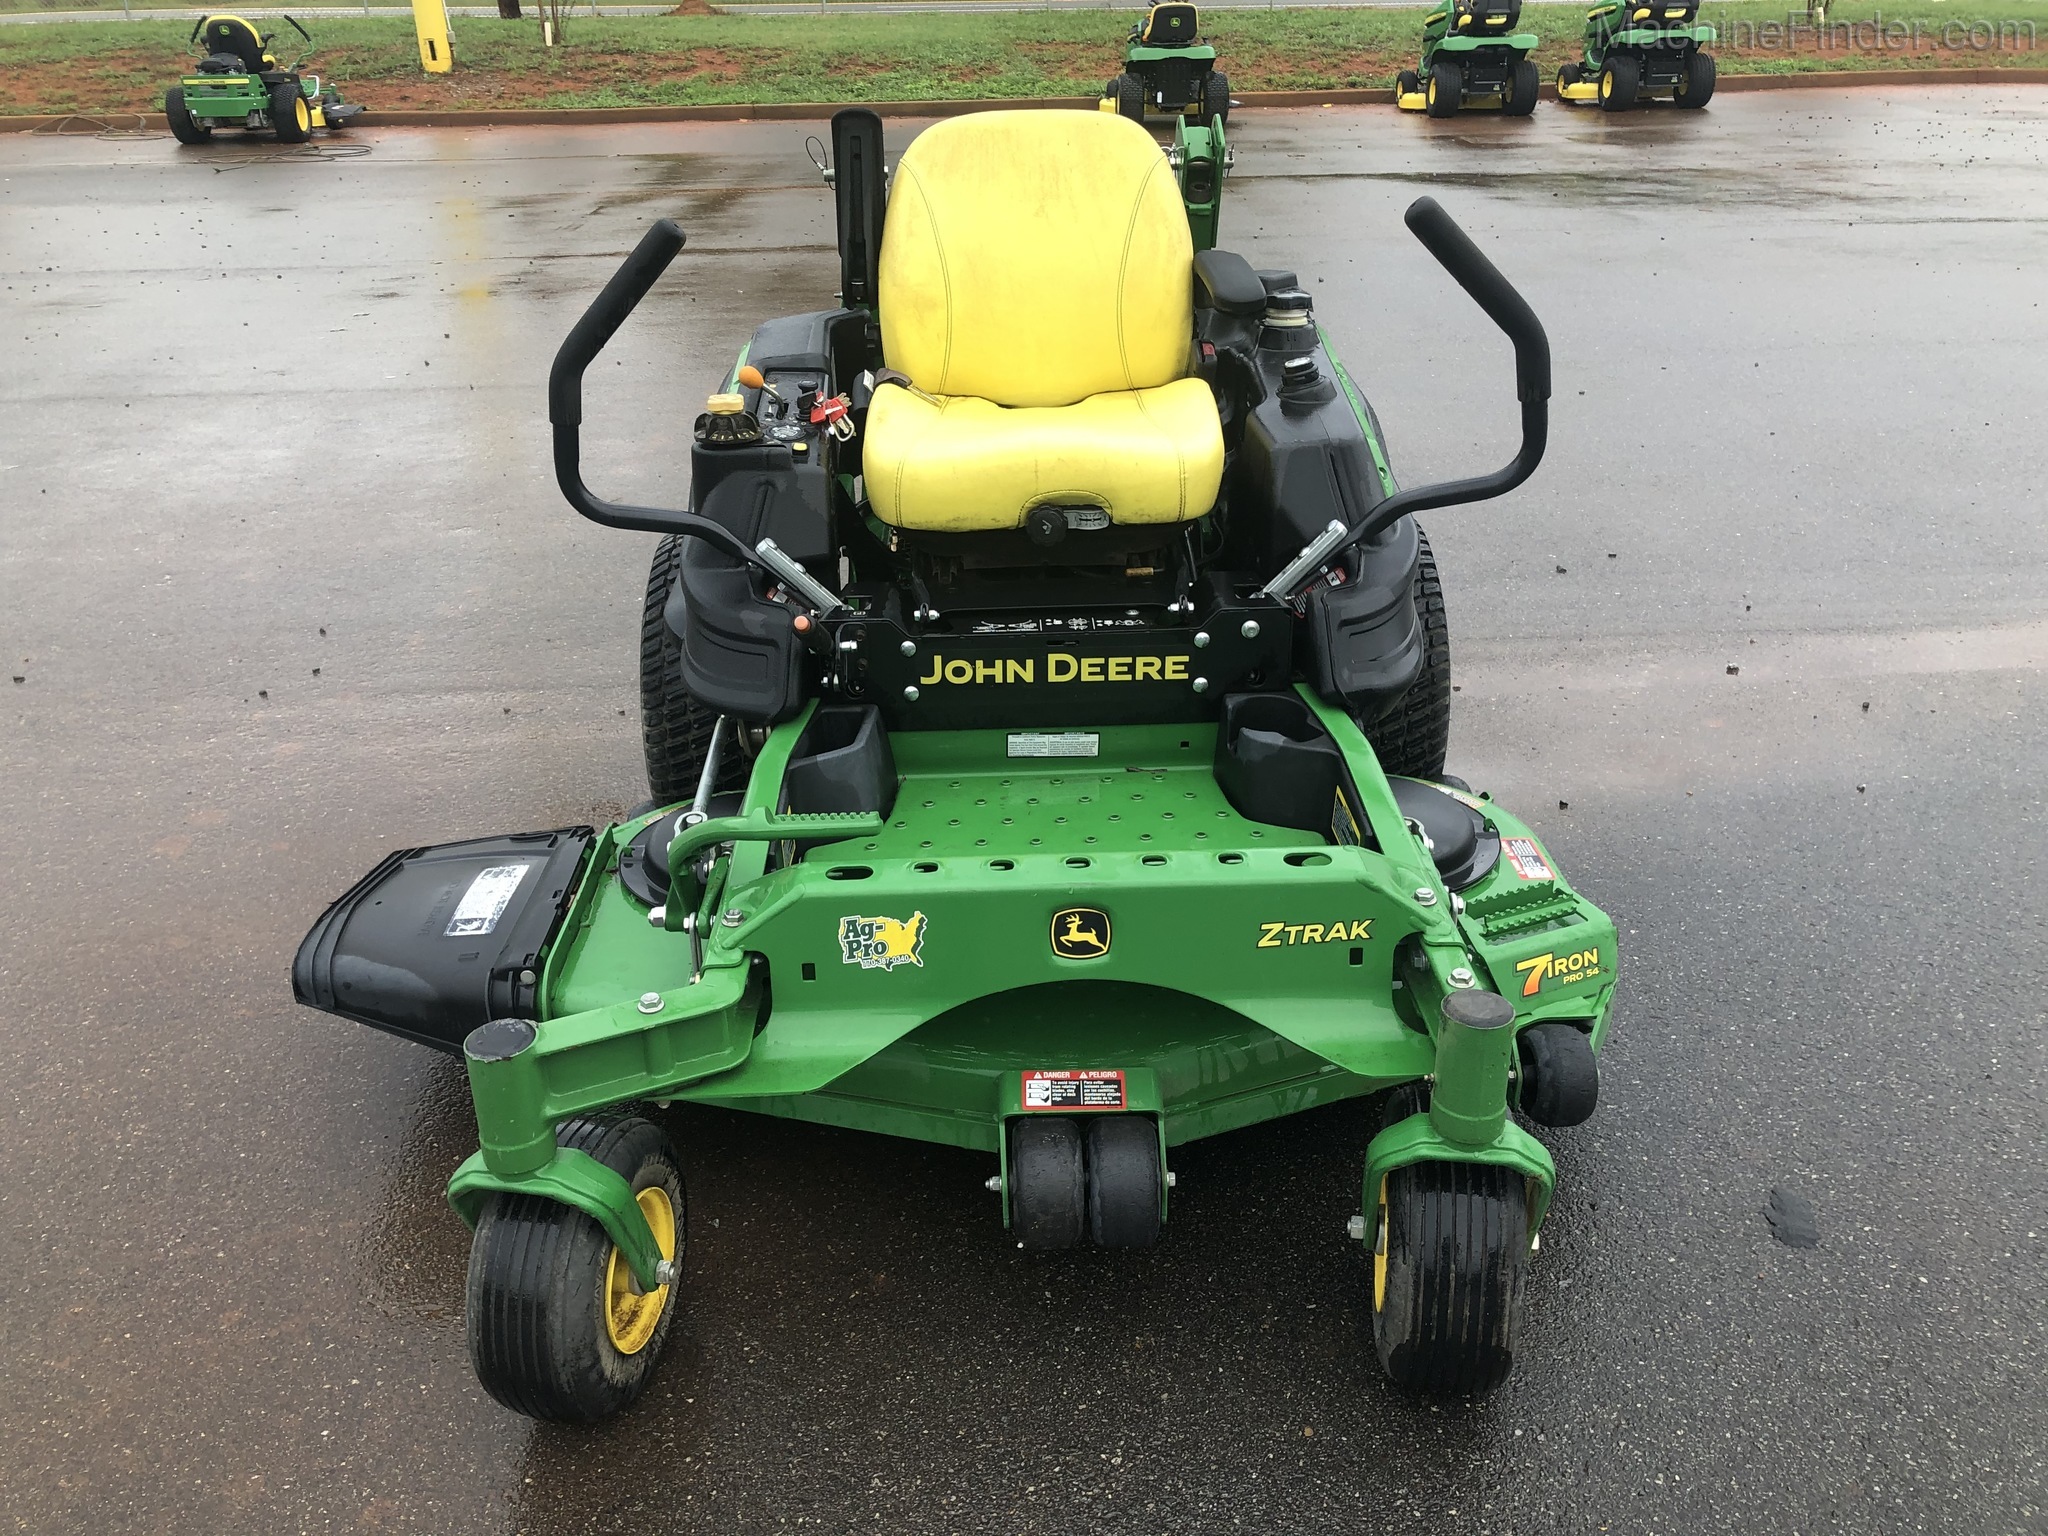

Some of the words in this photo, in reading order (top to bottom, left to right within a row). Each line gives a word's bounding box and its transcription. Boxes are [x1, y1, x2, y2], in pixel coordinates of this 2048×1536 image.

[920, 654, 1034, 685] JOHN
[1047, 653, 1190, 683] DEERE
[844, 919, 884, 942] Ag-
[1257, 919, 1374, 948] ZTRAK
[845, 939, 887, 960] Pro
[1563, 971, 1584, 985] PRO
[1586, 966, 1600, 978] 54
